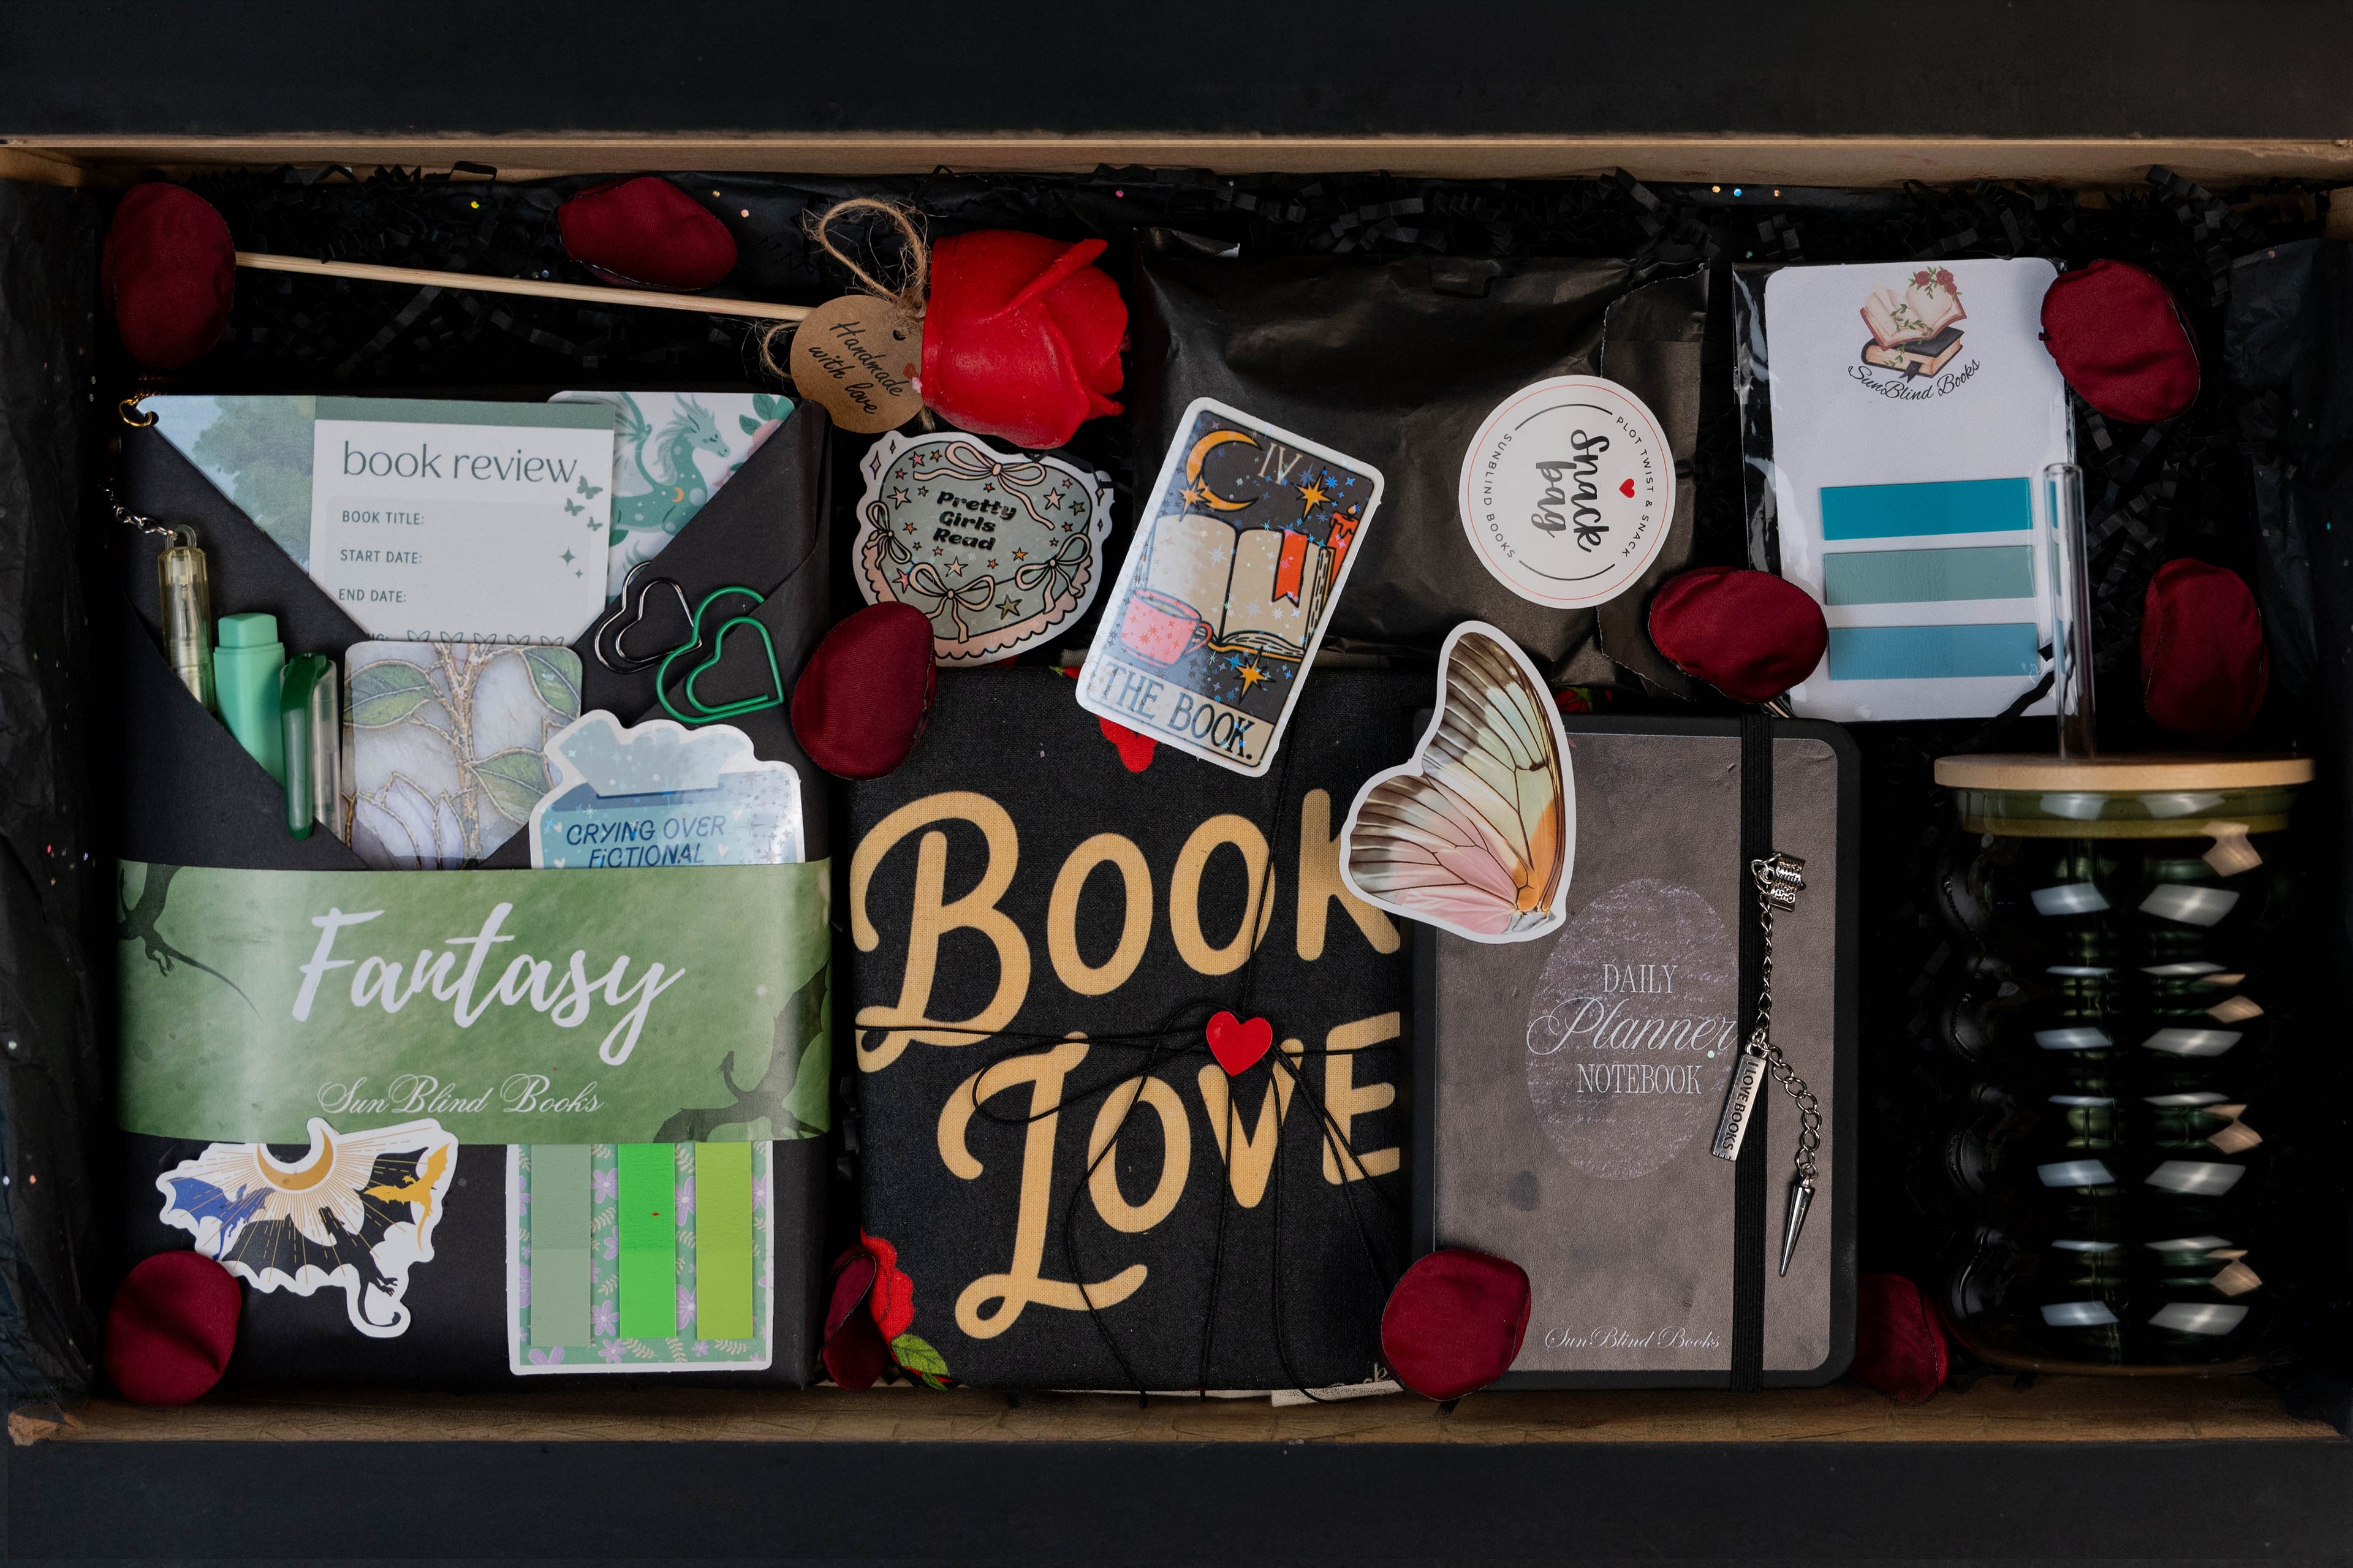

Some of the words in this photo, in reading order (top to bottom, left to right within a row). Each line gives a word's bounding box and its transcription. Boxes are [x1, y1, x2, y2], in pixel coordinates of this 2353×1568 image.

[830, 321, 910, 396] Handmade
[1936, 359, 1980, 397] Books
[808, 347, 855, 379] with
[844, 382, 878, 414] love
[1616, 416, 1643, 445] PLOT
[343, 441, 442, 478] book
[453, 449, 578, 483] review
[1257, 442, 1302, 485] IV
[1483, 433, 1512, 506] SUNBLIND
[1640, 449, 1654, 493] TWIST
[936, 491, 1017, 520] Pretty
[1531, 461, 1577, 538] bag
[1571, 429, 1610, 553] Snack
[343, 510, 380, 524] BOOK
[385, 512, 424, 525] TITLE:
[939, 510, 996, 532] Girls
[1487, 513, 1515, 558] BOOKS
[1621, 515, 1650, 557] SNACK
[340, 549, 379, 563] START
[386, 551, 423, 564] DATE:
[933, 527, 996, 551] Read
[339, 588, 365, 601] END
[371, 590, 406, 603] DATE:
[1103, 661, 1164, 721] THE
[1167, 690, 1255, 760] BOOK.
[567, 819, 656, 846] CRYING
[663, 815, 726, 839] OVER
[850, 789, 1402, 1073] BOOK
[292, 902, 686, 1066] Fantasy
[1602, 964, 1678, 993] DAILY
[1526, 996, 1739, 1055] Planner
[499, 1073, 605, 1114] Books
[1577, 1064, 1703, 1095] NOTEBOOK
[1737, 1069, 1757, 1103] LOVE
[1721, 1102, 1746, 1150] BOOKS
[1657, 1325, 1721, 1349] Books
